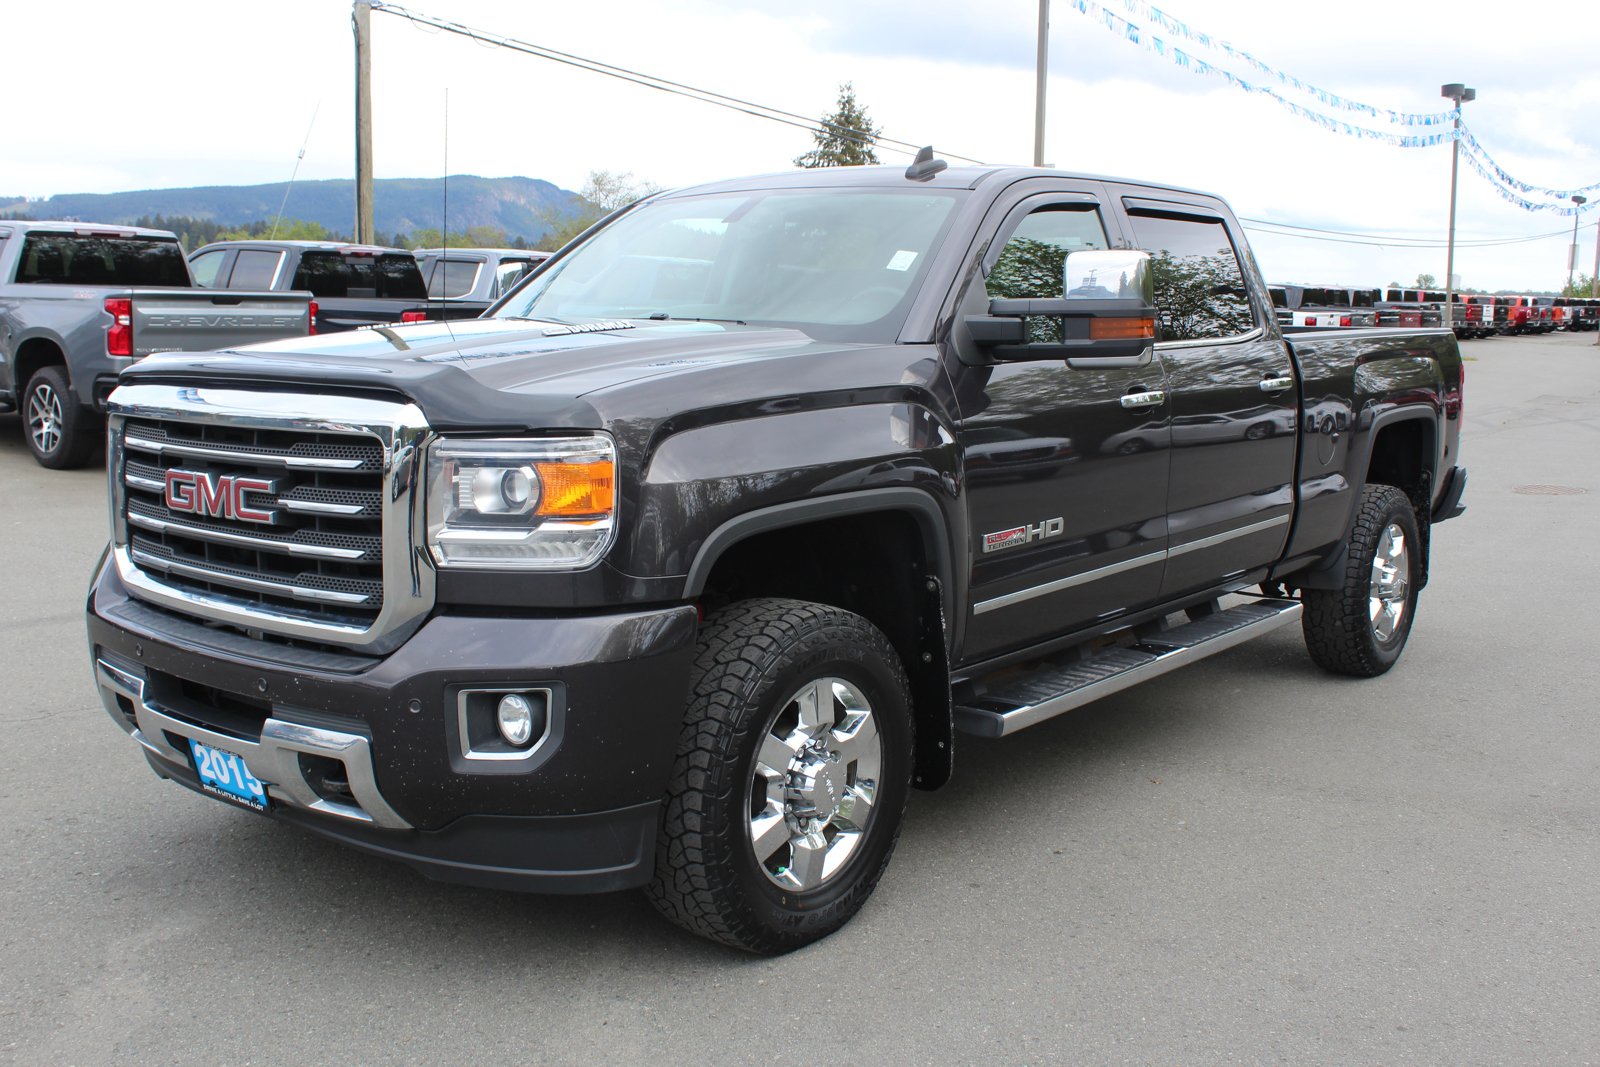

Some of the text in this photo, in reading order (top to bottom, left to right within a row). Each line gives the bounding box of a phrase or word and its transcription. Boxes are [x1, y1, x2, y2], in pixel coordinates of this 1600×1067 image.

[149, 316, 300, 326] CHEVROLET
[568, 321, 635, 334] DURAMAX
[165, 468, 276, 524] GMC
[1026, 516, 1064, 543] HD
[987, 537, 1024, 550] TERRAIN
